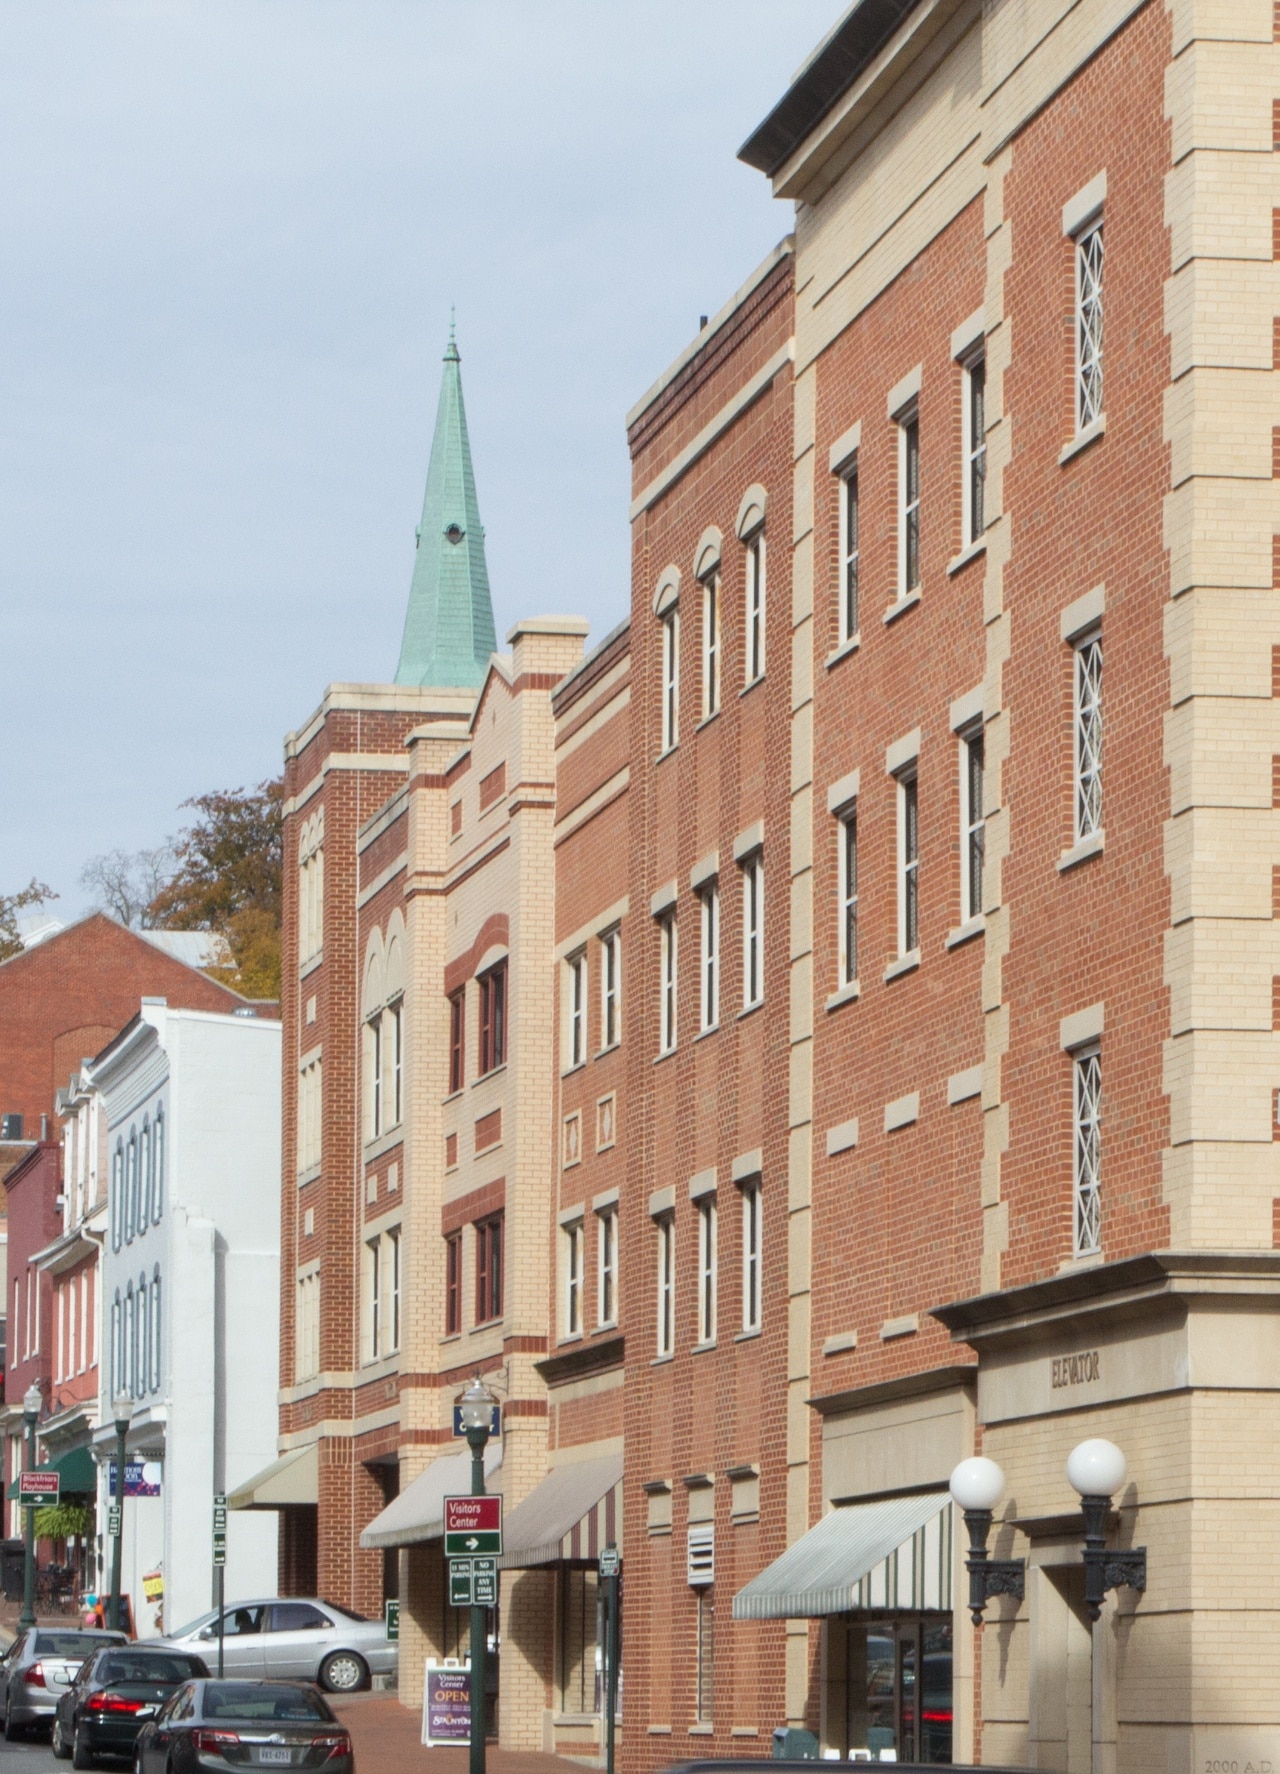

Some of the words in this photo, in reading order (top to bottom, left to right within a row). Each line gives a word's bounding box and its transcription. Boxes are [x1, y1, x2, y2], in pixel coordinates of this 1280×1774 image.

[1052, 1351, 1100, 1388] ELEVATOR
[449, 1502, 481, 1514] Visitors
[449, 1517, 478, 1528] Center
[438, 1673, 466, 1682] Visitors
[434, 1690, 470, 1702] OPEN
[1204, 1760, 1239, 1774] 2000
